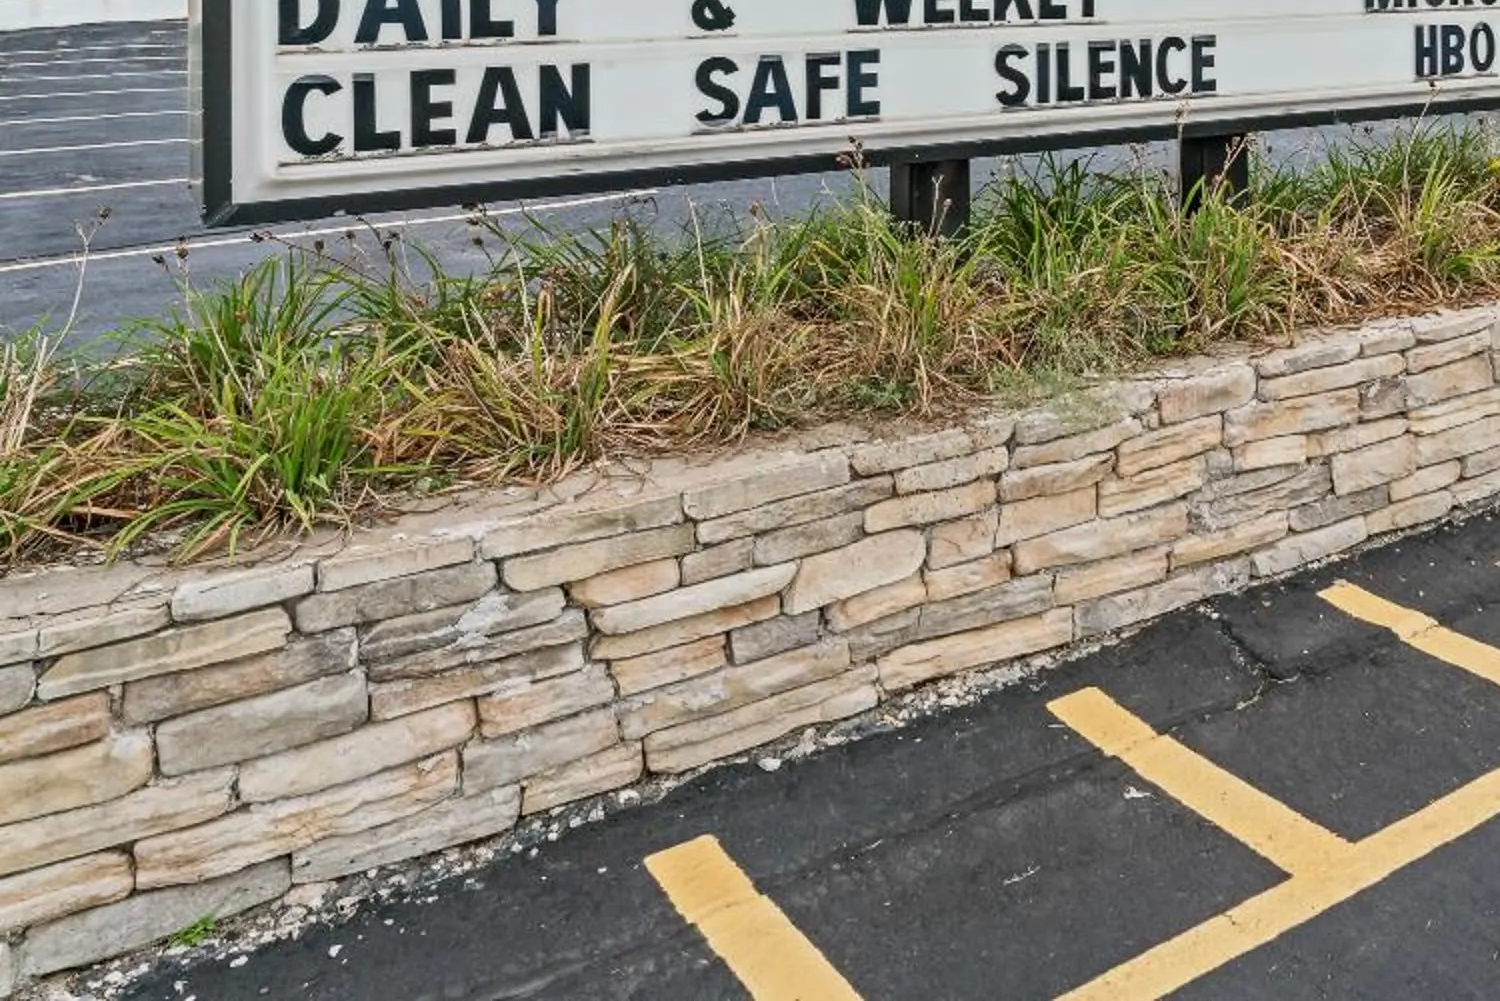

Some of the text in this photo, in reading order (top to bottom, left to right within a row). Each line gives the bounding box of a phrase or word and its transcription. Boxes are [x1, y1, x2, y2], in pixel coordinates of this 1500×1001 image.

[1415, 21, 1496, 77] HBO
[280, 34, 1218, 157] CLEAN SAFE SILENCE
